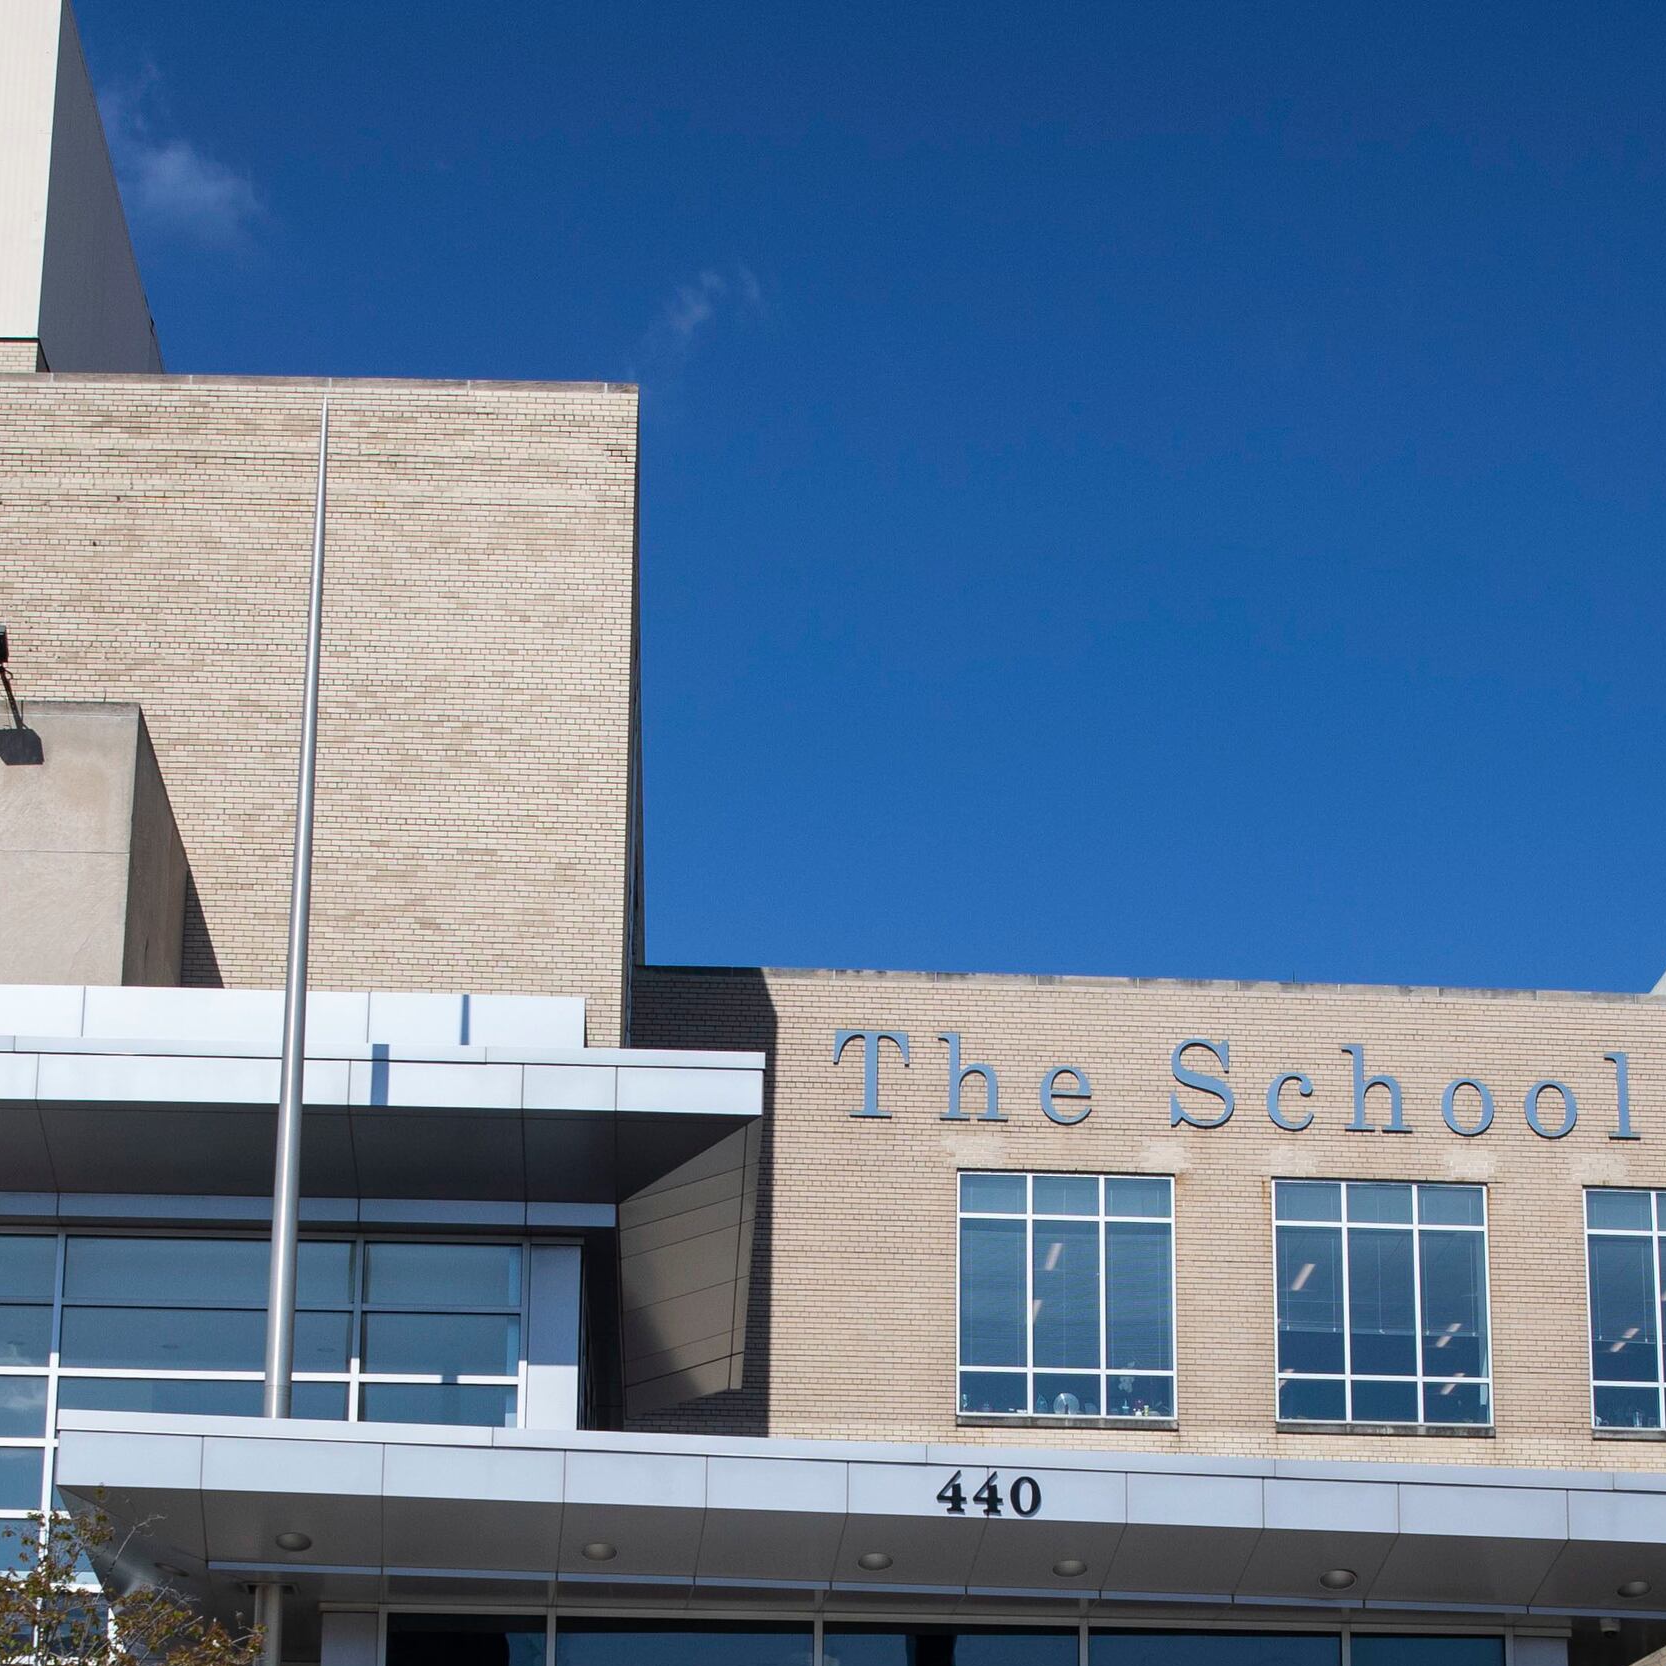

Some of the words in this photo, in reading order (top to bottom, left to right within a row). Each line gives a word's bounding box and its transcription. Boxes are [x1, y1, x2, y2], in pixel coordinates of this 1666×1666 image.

[833, 1029, 1093, 1125] The
[1169, 1037, 1642, 1140] School
[936, 1469, 1042, 1518] 440
